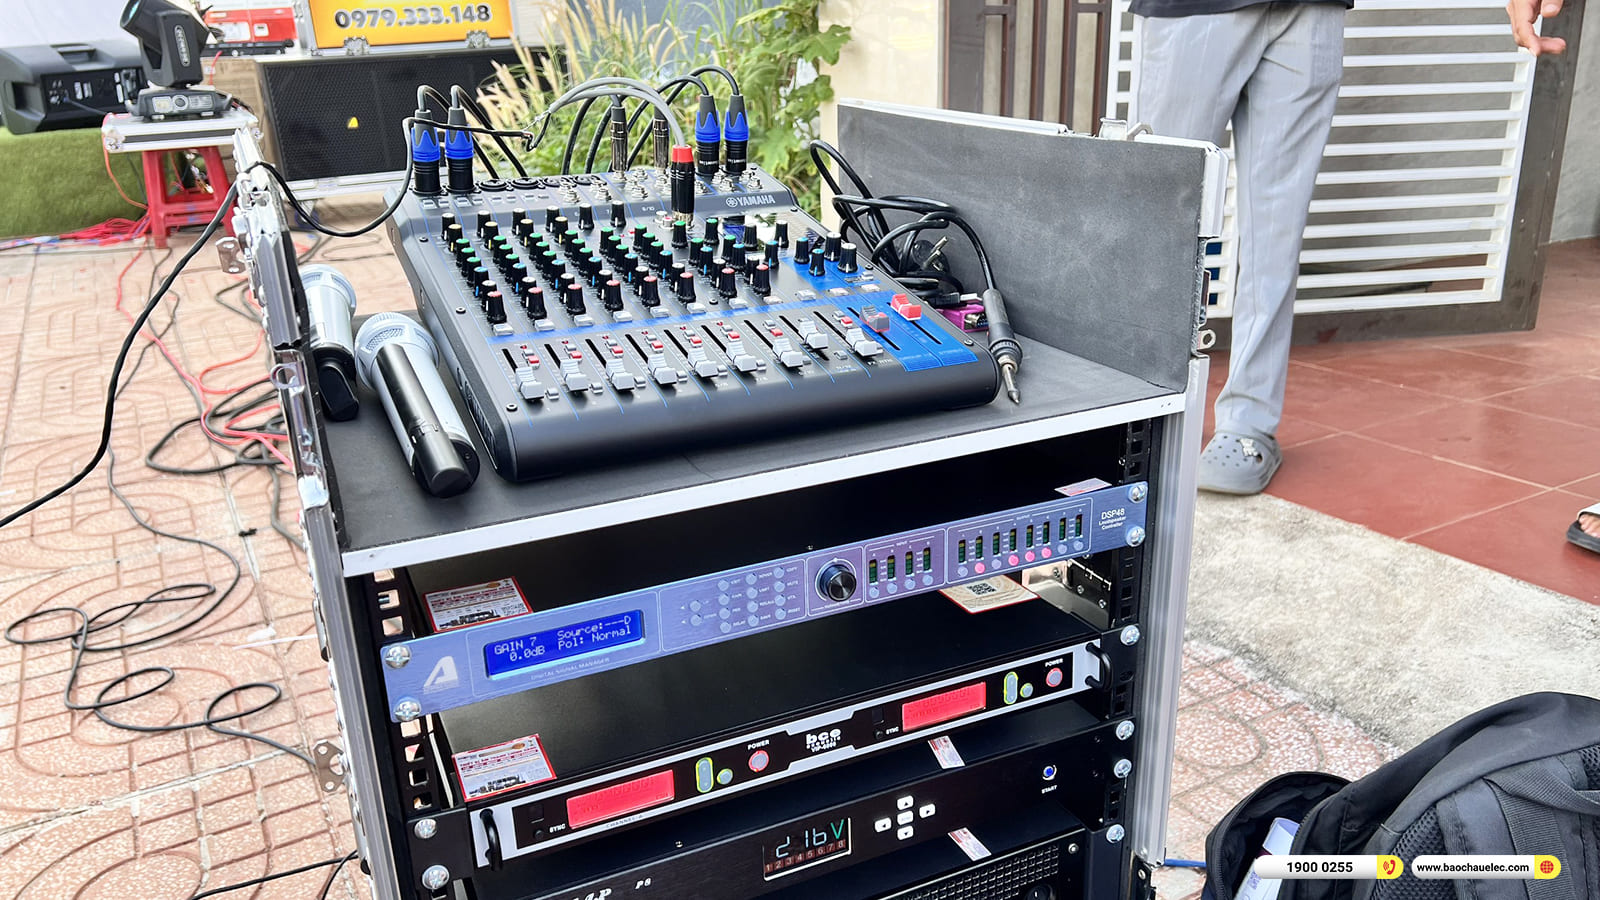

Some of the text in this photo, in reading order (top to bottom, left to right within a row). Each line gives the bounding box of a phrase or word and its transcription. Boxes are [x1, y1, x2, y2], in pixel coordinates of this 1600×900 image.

[335, 5, 492, 28] 0979.333.148
[737, 194, 776, 206] YAMAHA
[494, 640, 524, 655] GAIN
[530, 636, 537, 646] 7
[509, 625, 631, 662] 0.0dB Pol: Normal
[1044, 658, 1064, 667] POWER
[747, 739, 770, 750] POWER
[1041, 784, 1058, 794] START
[549, 823, 566, 833] SYNC
